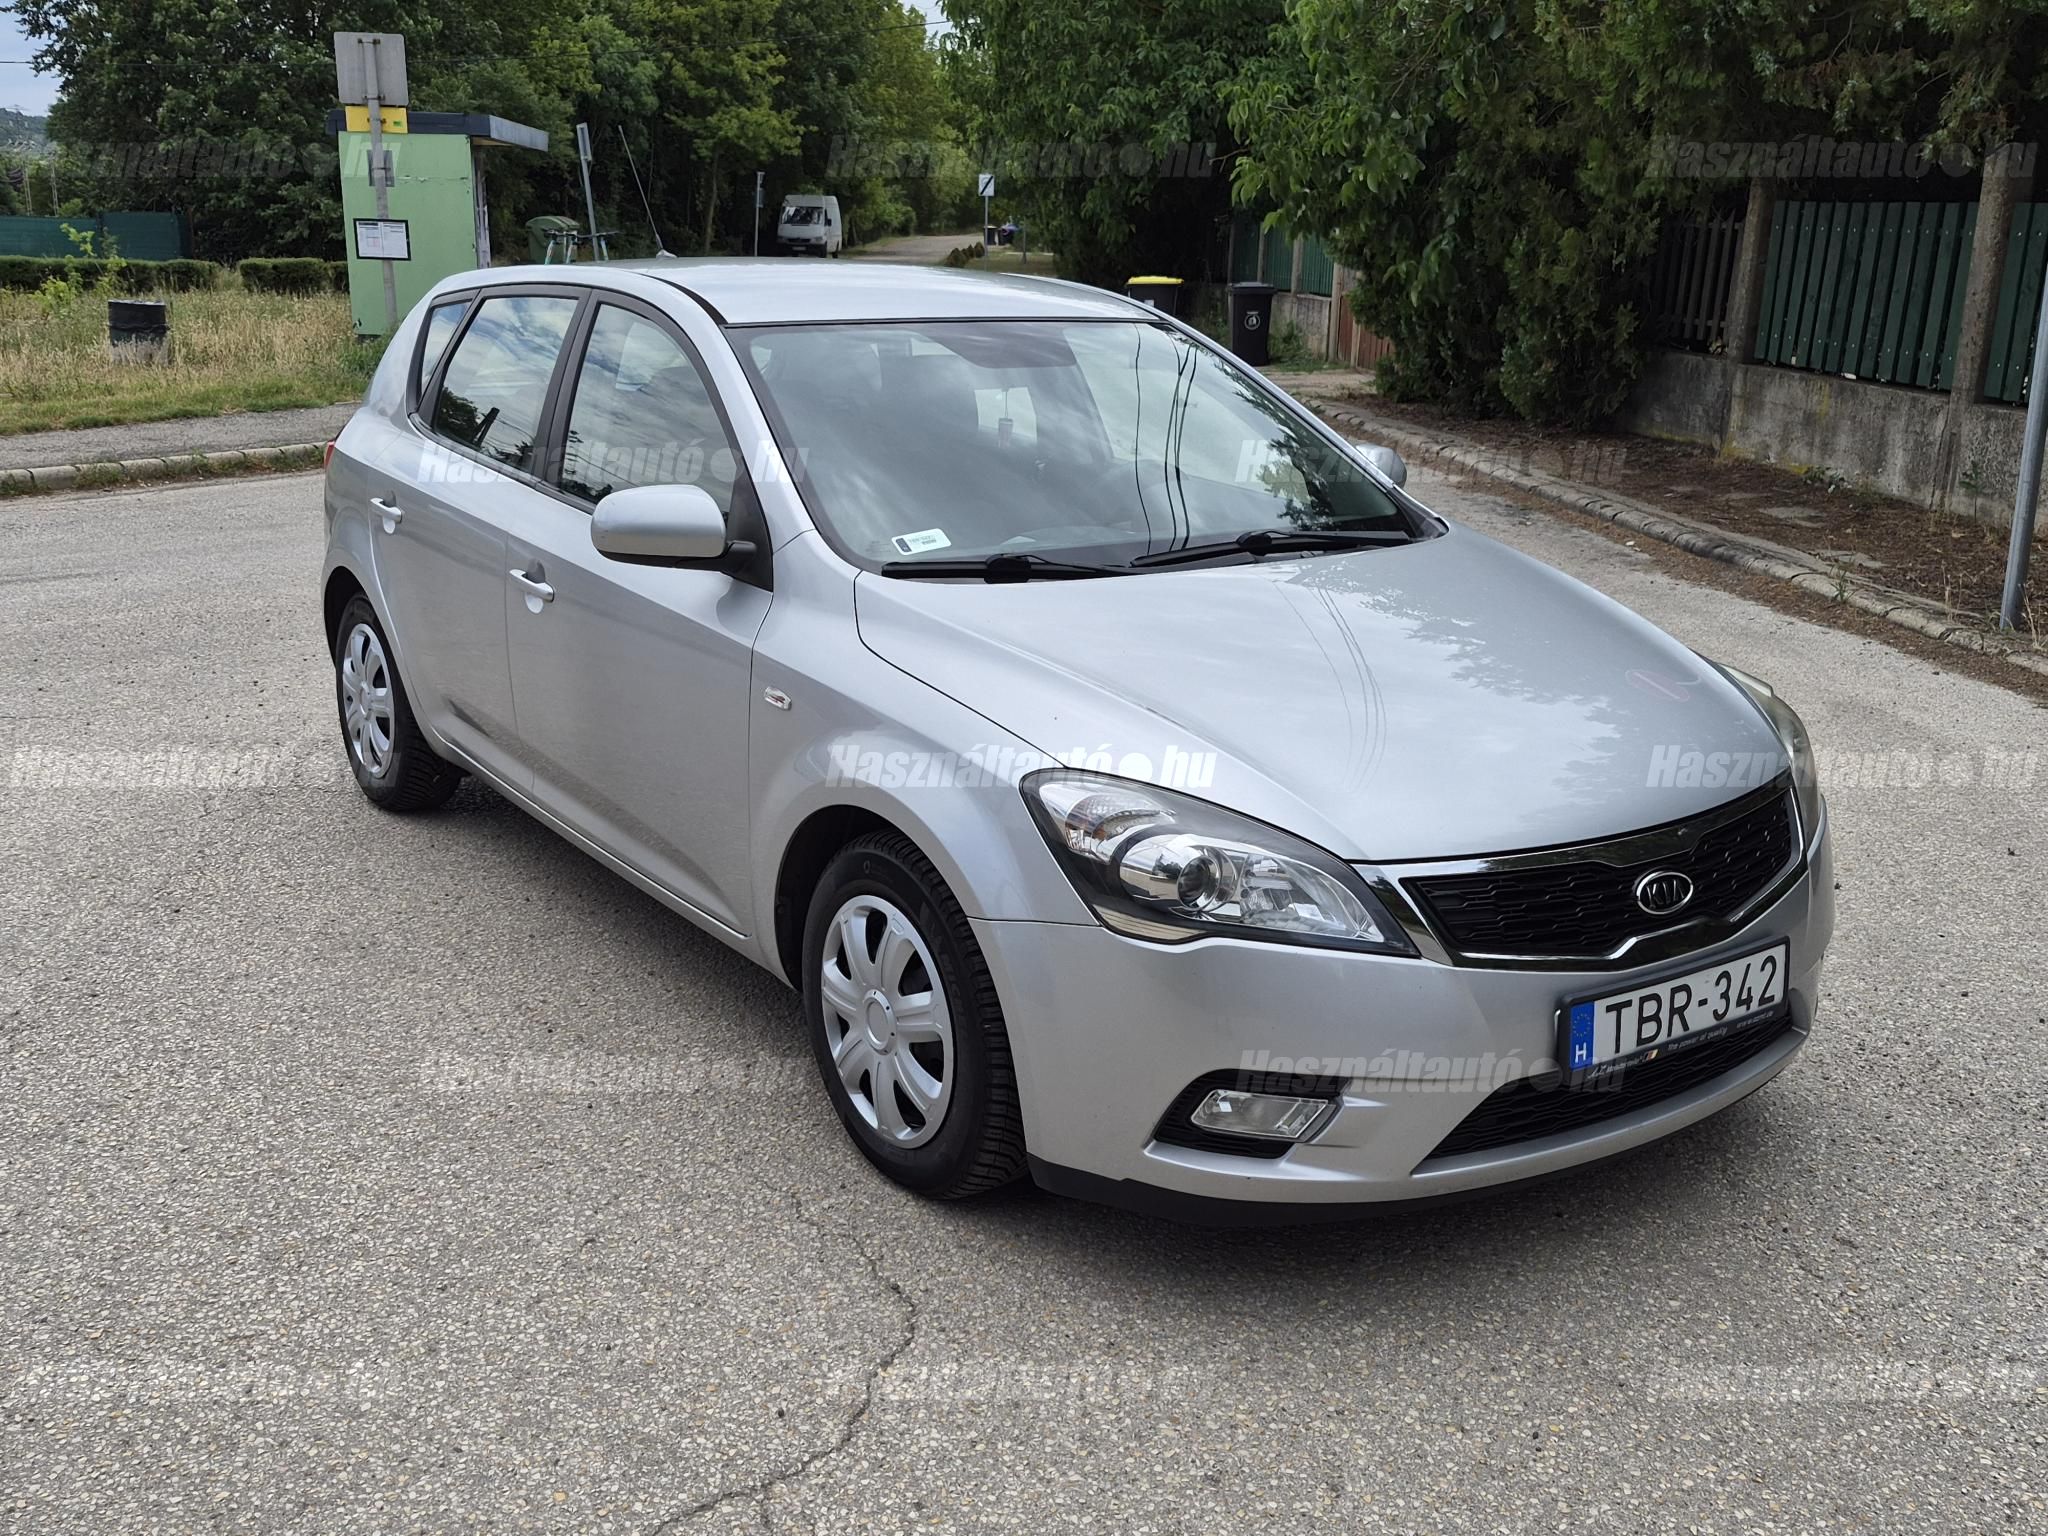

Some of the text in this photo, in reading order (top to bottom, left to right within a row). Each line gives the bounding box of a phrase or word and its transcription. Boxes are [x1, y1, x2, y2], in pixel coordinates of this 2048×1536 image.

[1645, 878, 1687, 908] KIA
[1605, 955, 1778, 1054] TBR-342
[1574, 1043, 1588, 1063] H
